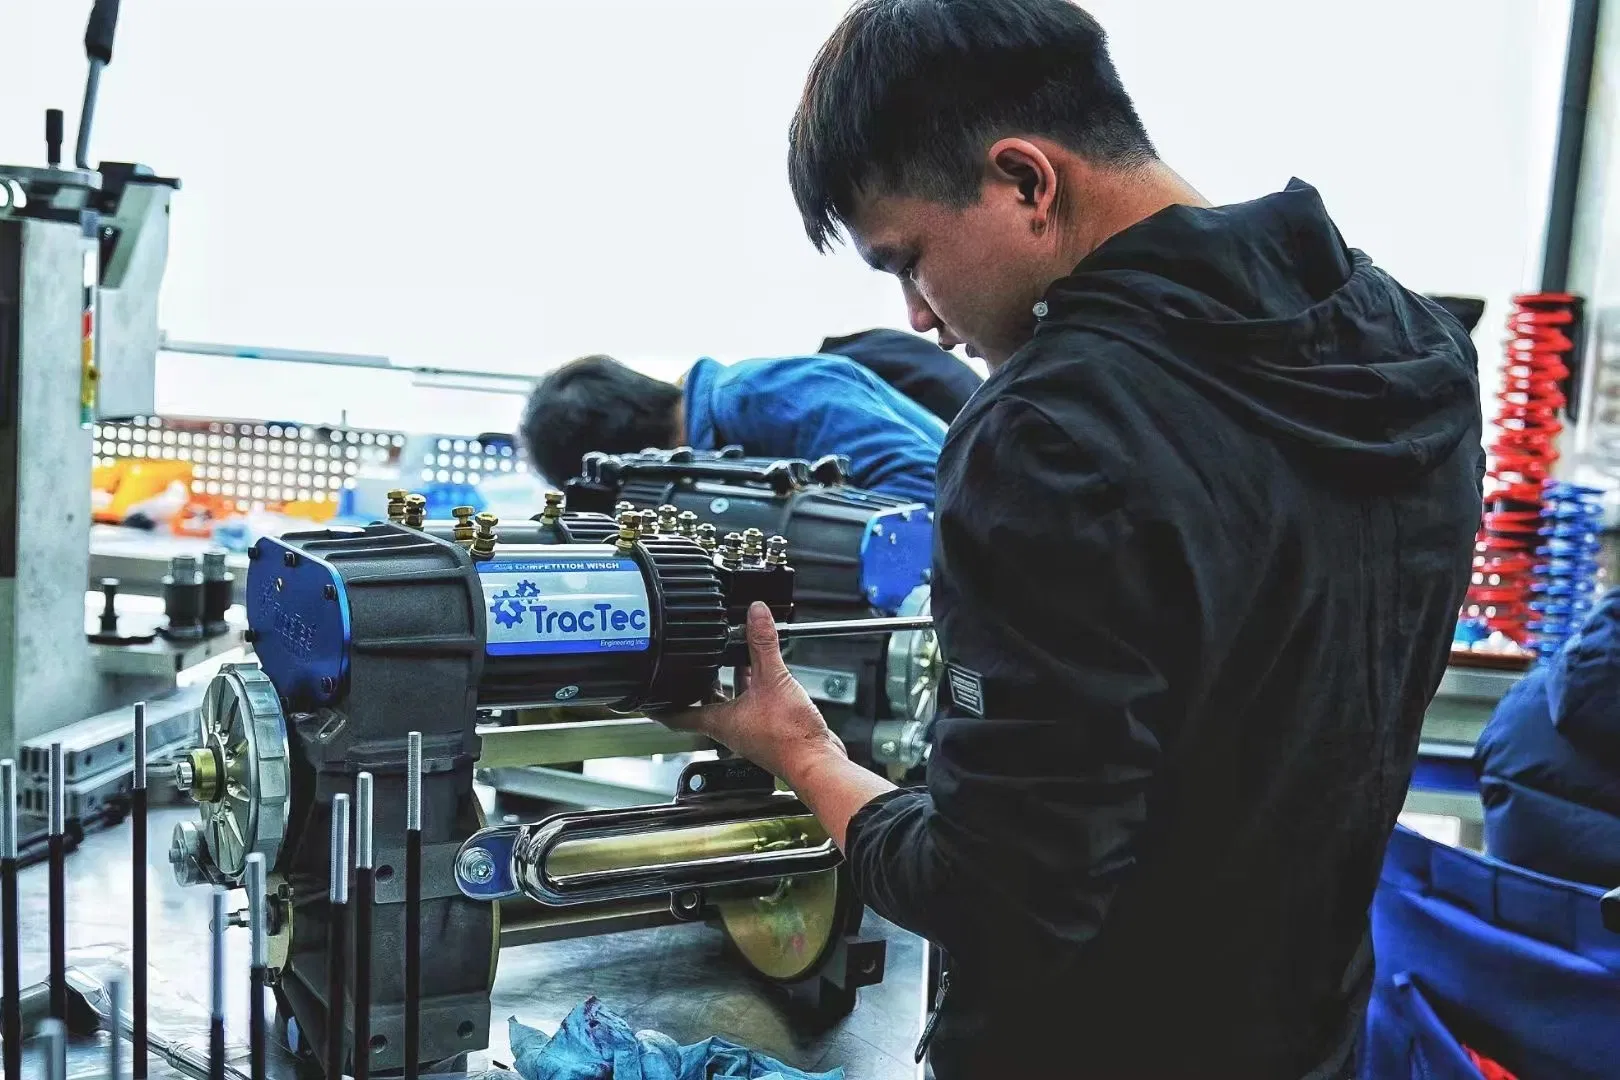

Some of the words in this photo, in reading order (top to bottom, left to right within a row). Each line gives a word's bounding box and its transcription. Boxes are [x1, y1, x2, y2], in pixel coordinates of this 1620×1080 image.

[514, 563, 584, 571] COMPETITION
[587, 562, 620, 570] WINCH
[530, 603, 647, 633] TracTec
[600, 639, 634, 648] Engineering
